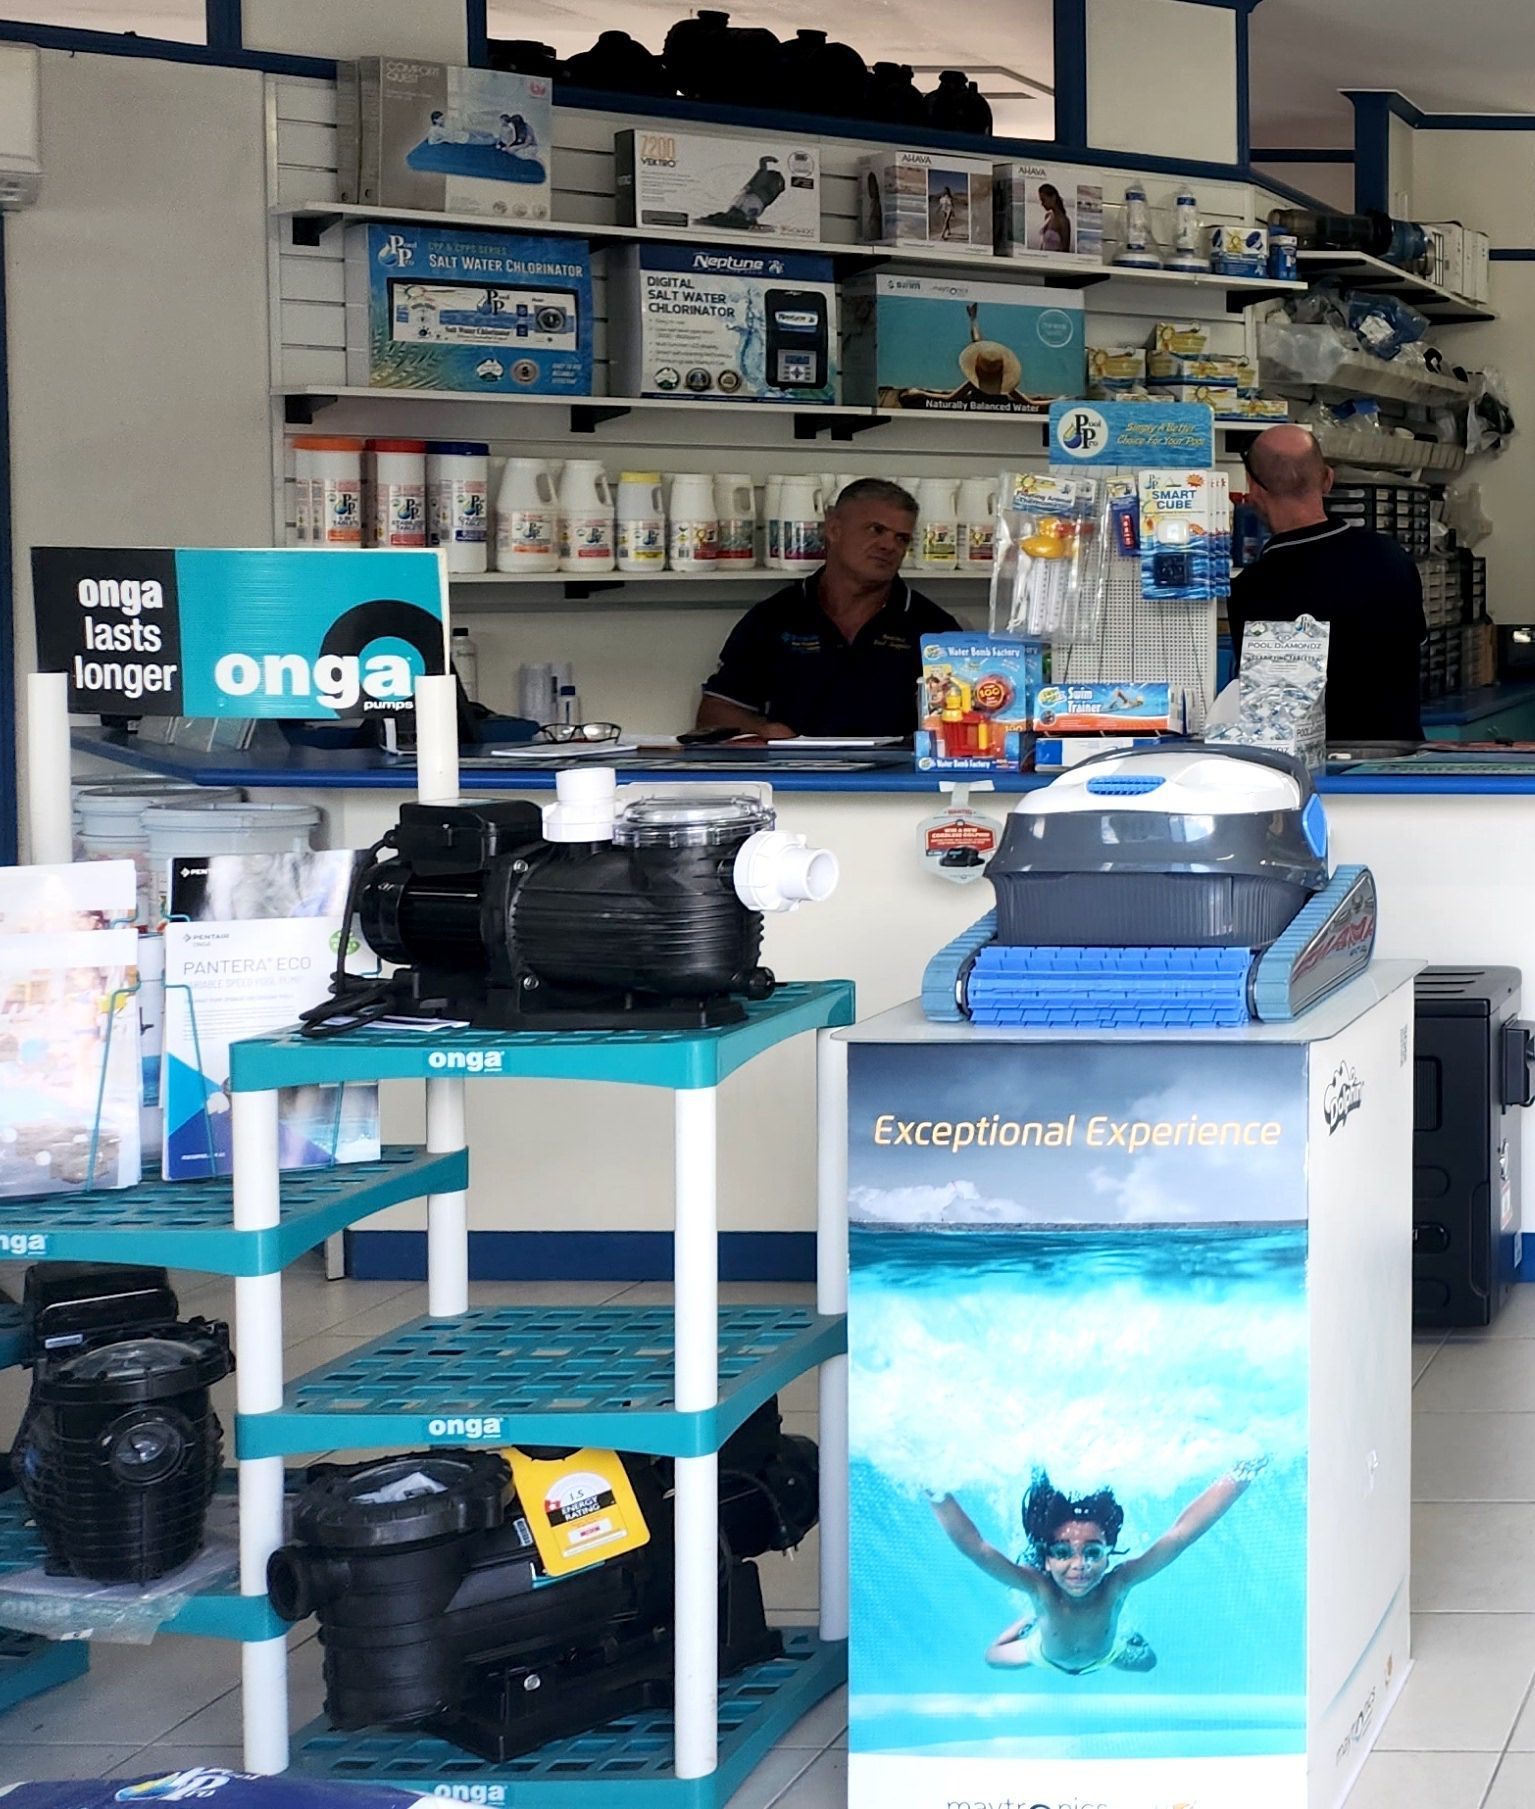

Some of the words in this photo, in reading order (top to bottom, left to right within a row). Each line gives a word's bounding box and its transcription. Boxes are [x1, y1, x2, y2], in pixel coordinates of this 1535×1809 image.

[902, 153, 932, 164] AHAVA
[1018, 166, 1047, 176] AHAVA
[429, 254, 457, 268] SALT
[462, 256, 502, 272] WATER
[506, 259, 583, 277] CHLORINATOR
[692, 254, 764, 271] Neptune
[647, 276, 694, 289] DIGITAL
[648, 290, 678, 301] SALT
[682, 292, 726, 304] WATER
[650, 303, 735, 317] CHLORINATOR
[926, 400, 968, 411] Naturally
[969, 401, 1011, 412] Balanced
[1013, 403, 1039, 413] Water
[1152, 490, 1198, 500] SMART
[1156, 500, 1192, 510] CUBE
[78, 577, 163, 616] onga
[84, 616, 162, 653] lasts
[947, 646, 969, 656] Water
[970, 646, 991, 656] Bomb
[992, 647, 1020, 658] Factory
[74, 655, 177, 699] longer
[214, 653, 414, 709] onga
[980, 687, 1000, 698] 100
[1068, 686, 1093, 699] Swim
[363, 701, 414, 712] pumps
[1068, 701, 1101, 713] Trainer
[936, 759, 952, 768] Water
[953, 760, 969, 768] Bomb
[969, 760, 991, 769] Factory
[193, 933, 230, 941] PENTAIR
[276, 956, 312, 971] ECO
[428, 1050, 501, 1073] onga
[873, 1113, 1076, 1153] Exceptional
[1085, 1114, 1283, 1152] Experience
[0, 1233, 47, 1255] nga
[428, 1417, 502, 1439] onga
[561, 1495, 599, 1516] ENERGY
[564, 1503, 601, 1522] RATING
[434, 1784, 505, 1805] onga
